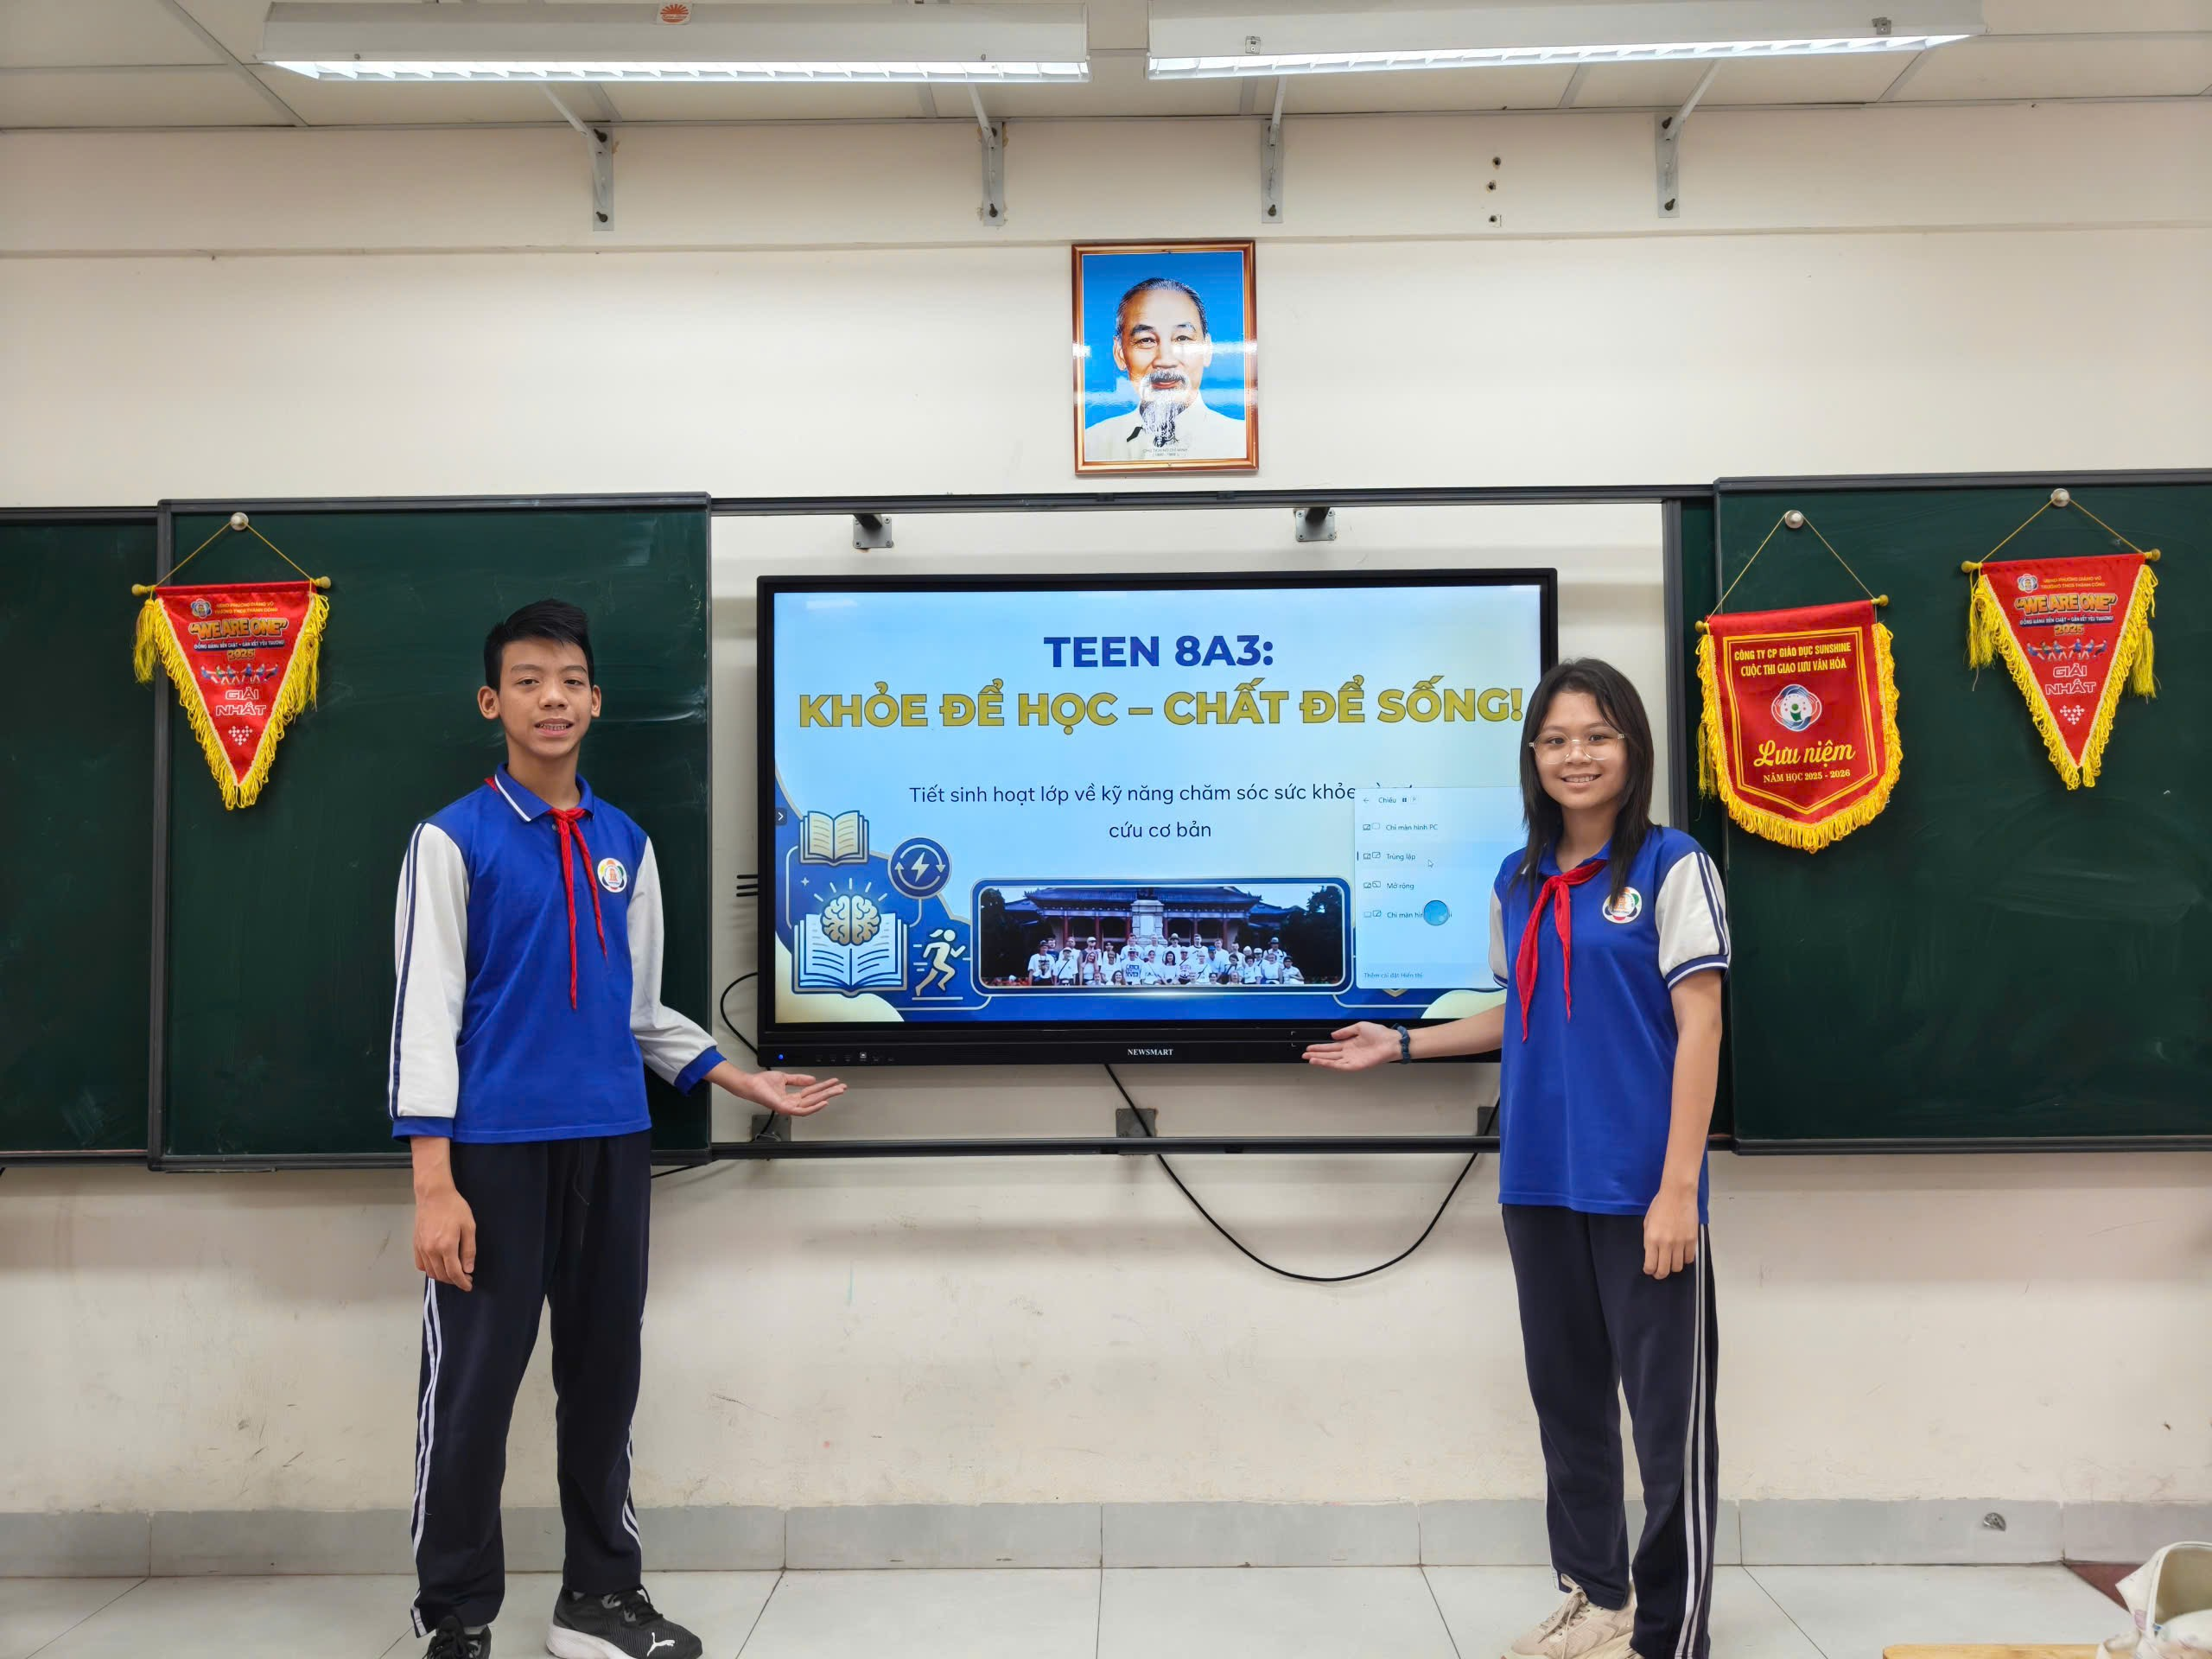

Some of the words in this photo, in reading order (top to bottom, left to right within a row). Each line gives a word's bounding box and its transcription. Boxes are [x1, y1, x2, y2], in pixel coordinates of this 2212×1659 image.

[2049, 594, 2079, 613] ARE
[222, 619, 251, 637] ARE
[1044, 636, 1160, 668] TEEN
[1174, 635, 1274, 667] 8A3:
[1734, 650, 1755, 661] CÔNG
[1757, 649, 1765, 659] TY
[1767, 648, 1777, 658] CP
[1780, 645, 1797, 658] GIÁO
[1798, 645, 1813, 658] DỤC
[1815, 642, 1852, 655] SUNSHINE
[1741, 664, 1762, 677] CUỘC
[1764, 664, 1776, 675] THI
[1777, 662, 1796, 674] GIAO
[1797, 660, 1812, 672] LƯU
[1813, 658, 1828, 671] VĂN
[1829, 655, 1847, 670] HÓA
[2052, 663, 2088, 678] GIẢI
[225, 686, 259, 701] GIẢI
[2044, 678, 2097, 696] NHẤT
[216, 701, 267, 716] NHẤT
[799, 681, 929, 728] KHỎE
[939, 677, 1005, 727] ĐỂ
[1018, 692, 1119, 736] HỌC
[1163, 677, 1290, 726] CHẤT
[1300, 674, 1366, 724] ĐỂ
[1376, 675, 1523, 723] SỐNG!
[1752, 740, 1802, 767] Lưu
[1802, 739, 1856, 768] niệm
[1763, 772, 1784, 783] NĂM
[1785, 772, 1803, 784] HỌC
[1804, 772, 1823, 780] 2025
[1829, 768, 1851, 779] 2026
[909, 784, 945, 803] Tiết
[950, 786, 988, 803] sinh
[993, 785, 1036, 806] hoạt
[1041, 785, 1069, 806] lớp
[1074, 782, 1096, 802] về
[1102, 785, 1122, 805] kỹ
[1128, 785, 1174, 805] năng
[1179, 784, 1231, 802] chăm
[1236, 783, 1269, 800] sóc
[1274, 783, 1306, 800] sức
[1313, 782, 1356, 800] khỏe
[1378, 795, 1397, 804] Chiếu
[1109, 821, 1143, 838] cứu
[1148, 824, 1171, 838] cơ
[1176, 820, 1211, 837] bản
